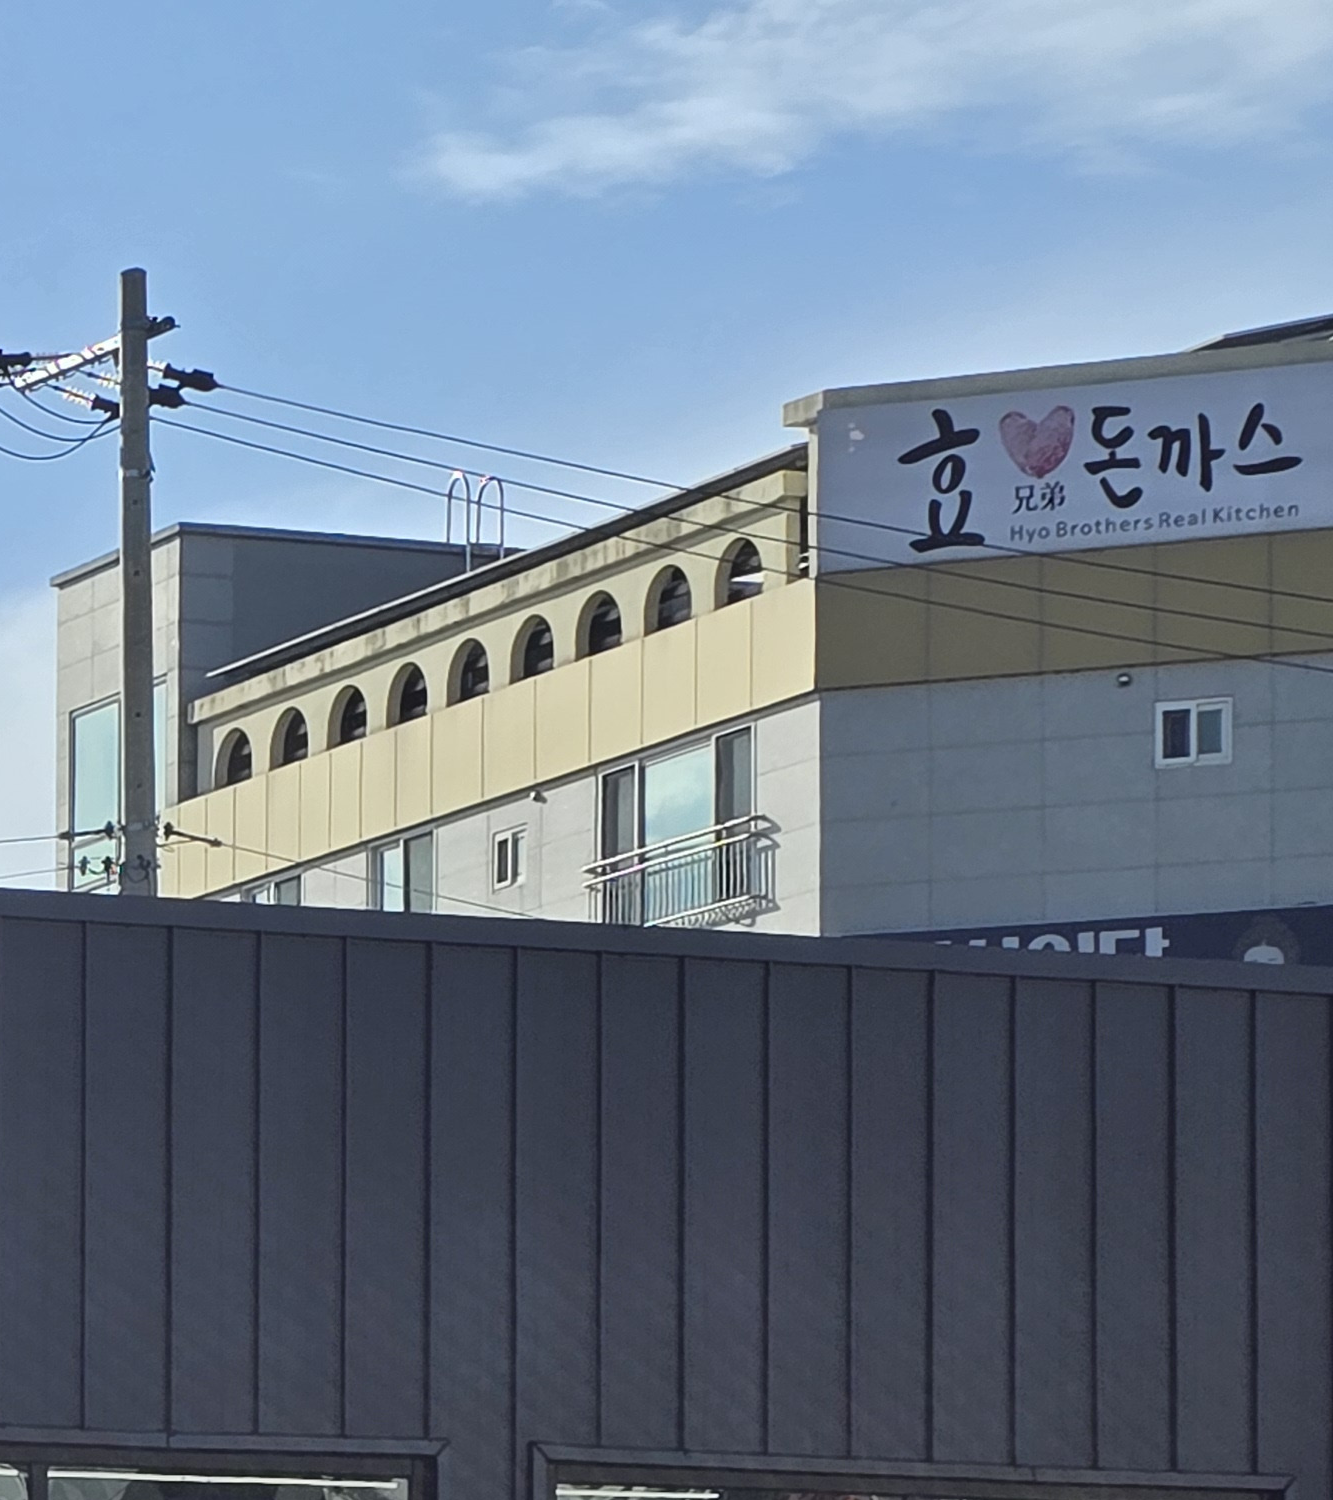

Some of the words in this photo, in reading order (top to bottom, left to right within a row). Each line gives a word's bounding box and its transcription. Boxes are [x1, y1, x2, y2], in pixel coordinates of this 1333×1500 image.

[897, 407, 985, 553] 효
[1083, 402, 1303, 509] 돈까스
[1011, 481, 1066, 514] 兄弟
[1009, 524, 1051, 544] Hyo
[1055, 515, 1154, 537] Brothers
[1158, 508, 1207, 529] Real
[1212, 502, 1300, 524] Kitchen
